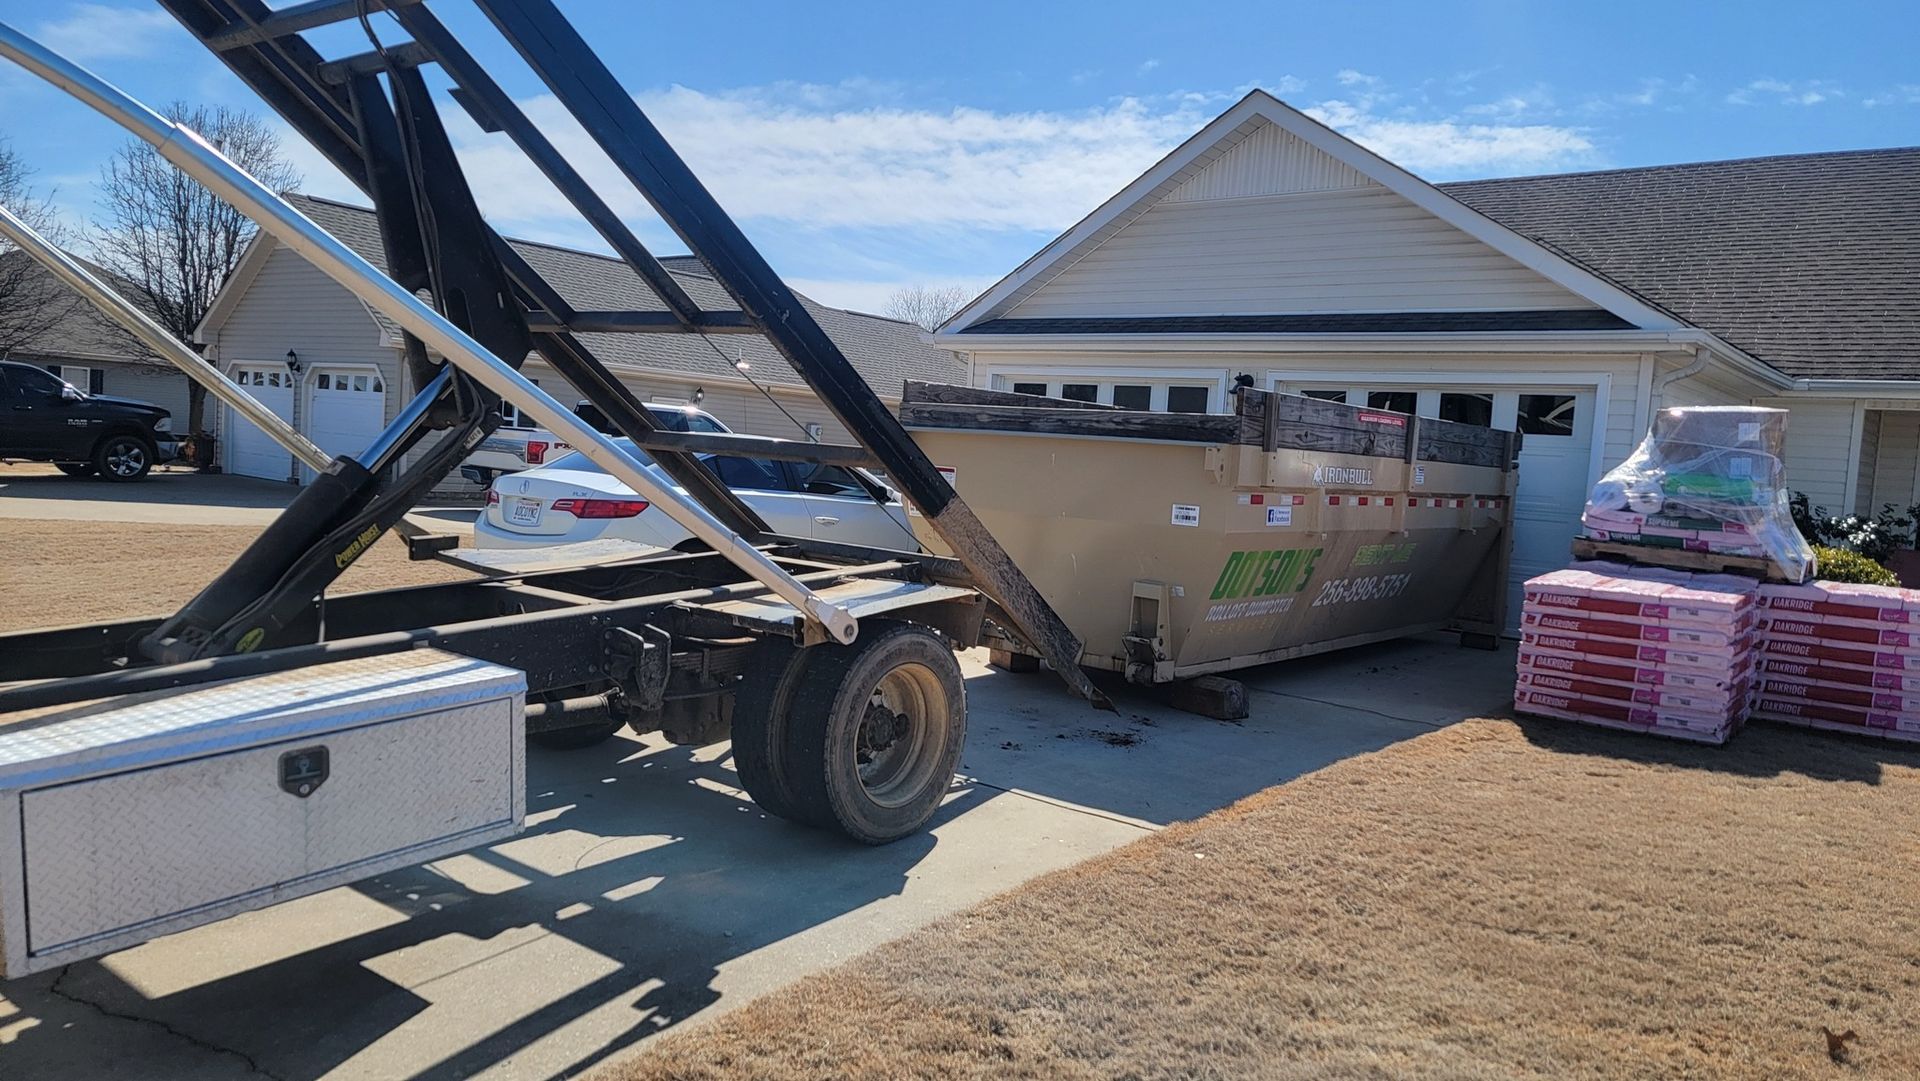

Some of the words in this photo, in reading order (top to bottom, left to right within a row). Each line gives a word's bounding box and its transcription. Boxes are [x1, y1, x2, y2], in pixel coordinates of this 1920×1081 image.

[1324, 466, 1373, 485] IRONBULL
[1541, 593, 1580, 607] OAKRIDGE
[1773, 599, 1815, 611] OAKRIDGE
[1541, 617, 1580, 631] OAKRIDGE
[1773, 621, 1815, 635] OAKRIDGE
[1539, 636, 1577, 650] OAKRIDGE
[1770, 641, 1811, 656] OAKRIDGE
[1536, 655, 1574, 671] OAKRIDGE
[1768, 660, 1808, 676] OAKRIDGE
[1534, 675, 1573, 690] OAKRIDGE
[1767, 681, 1808, 696] OAKRIDGE
[1531, 693, 1569, 709] OAKRIDGE
[1762, 700, 1801, 715] OAKRIDGE
